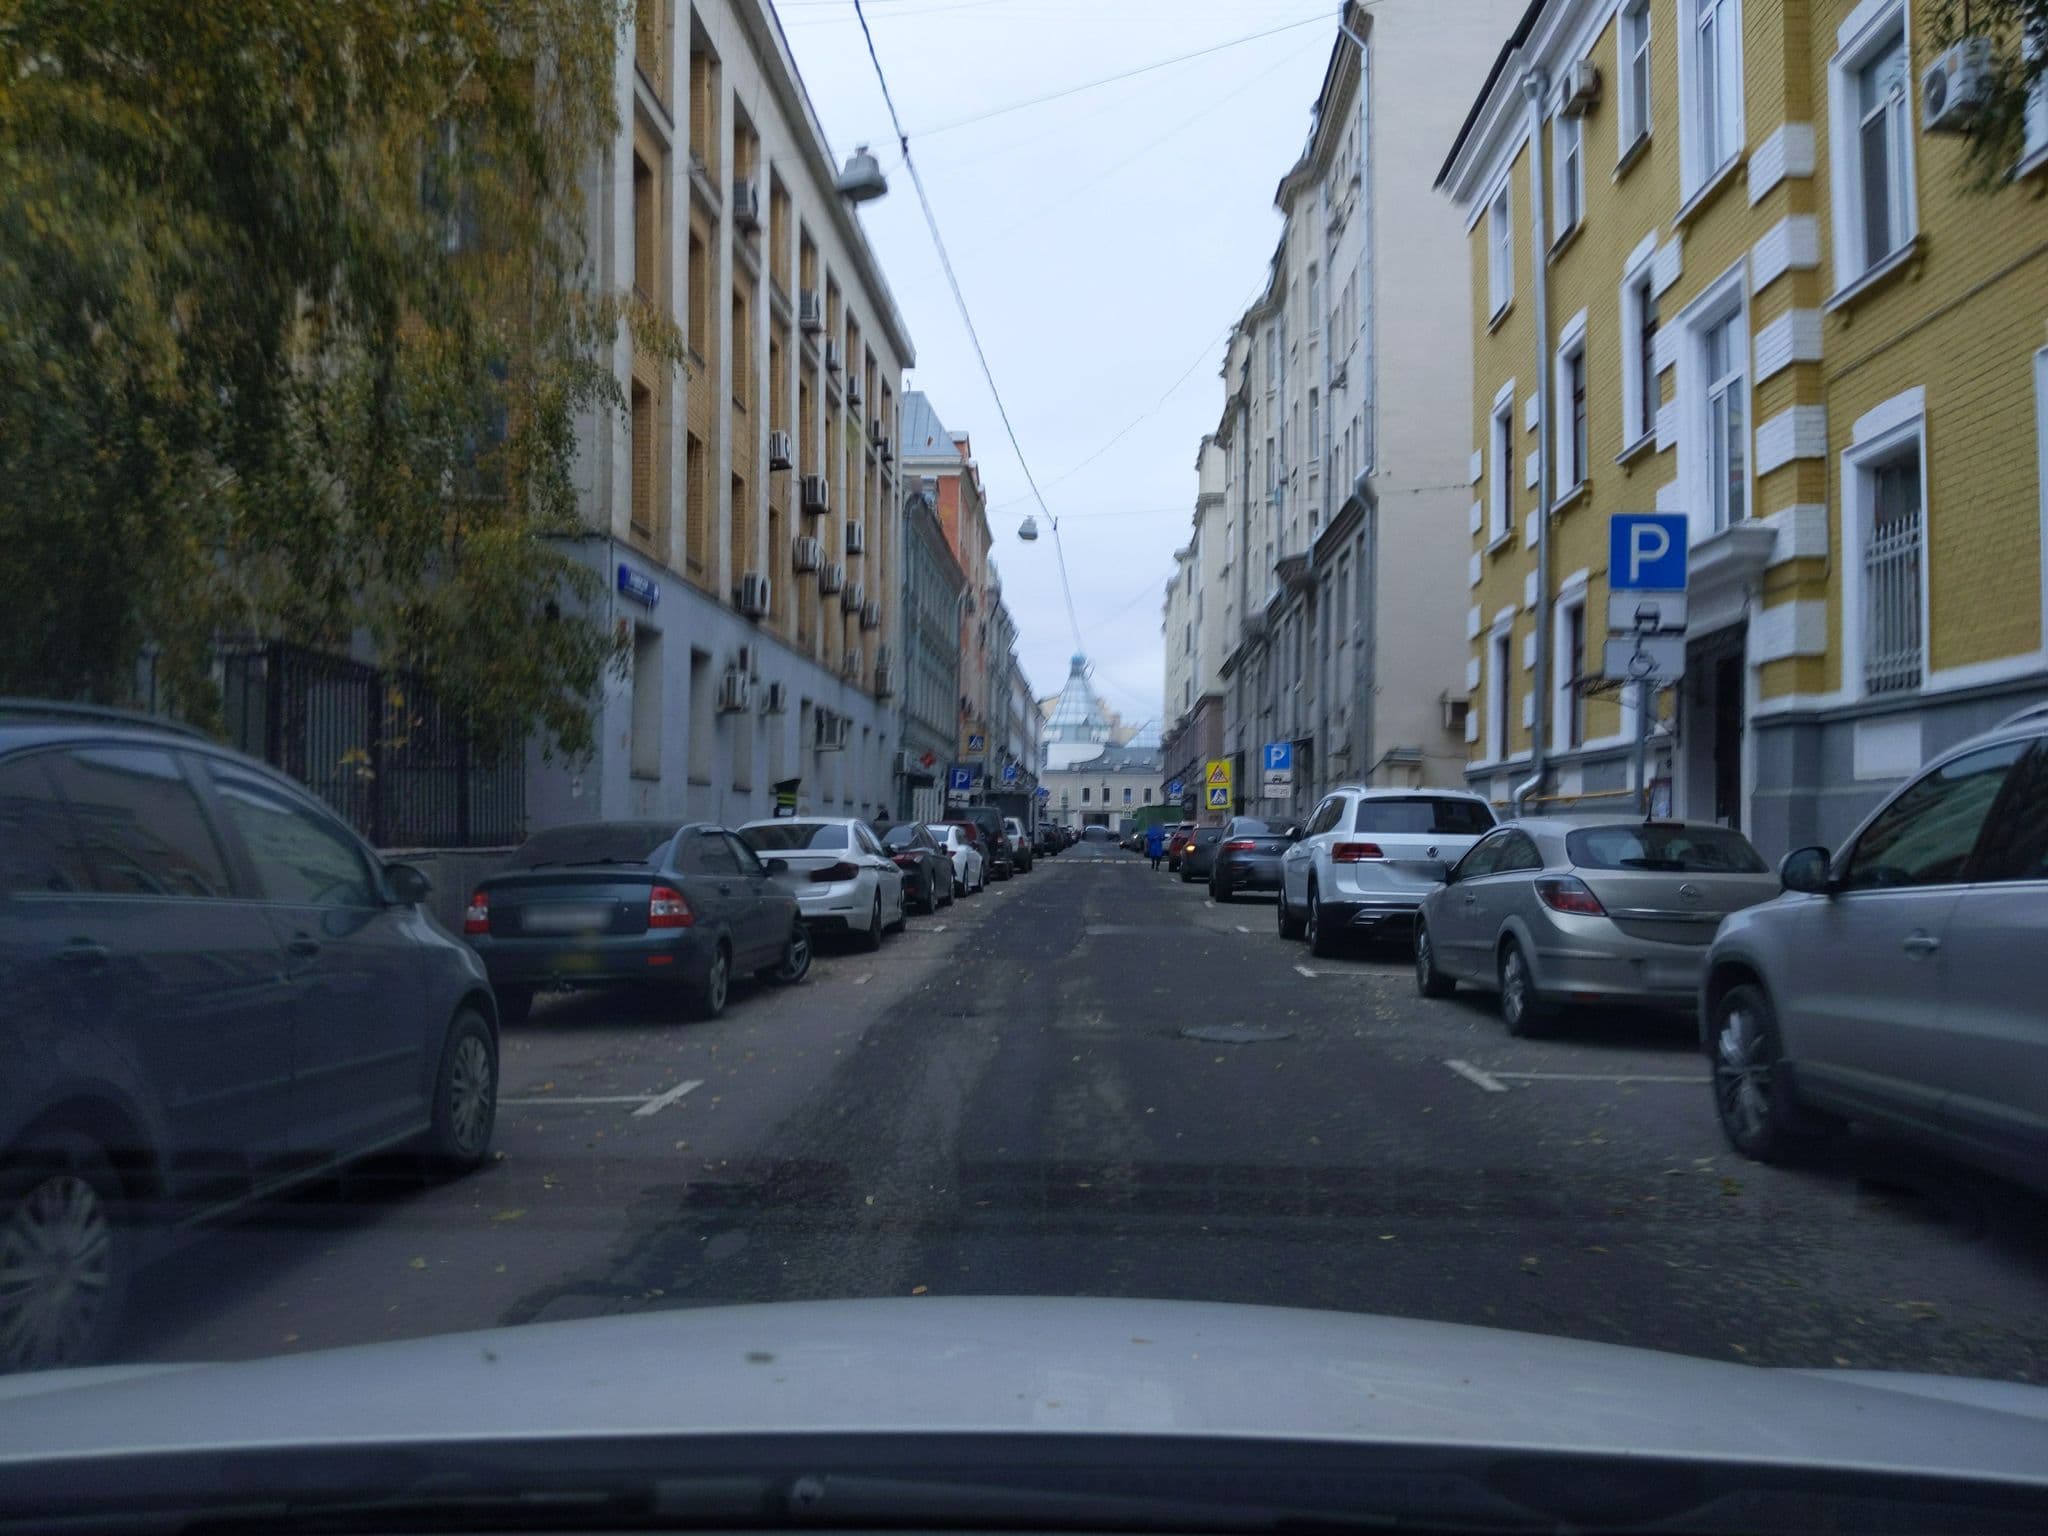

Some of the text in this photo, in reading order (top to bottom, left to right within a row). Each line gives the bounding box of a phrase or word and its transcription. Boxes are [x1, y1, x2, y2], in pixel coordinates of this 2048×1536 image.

[1629, 523, 1670, 584] P
[1271, 747, 1286, 769] P
[955, 771, 968, 788] P
